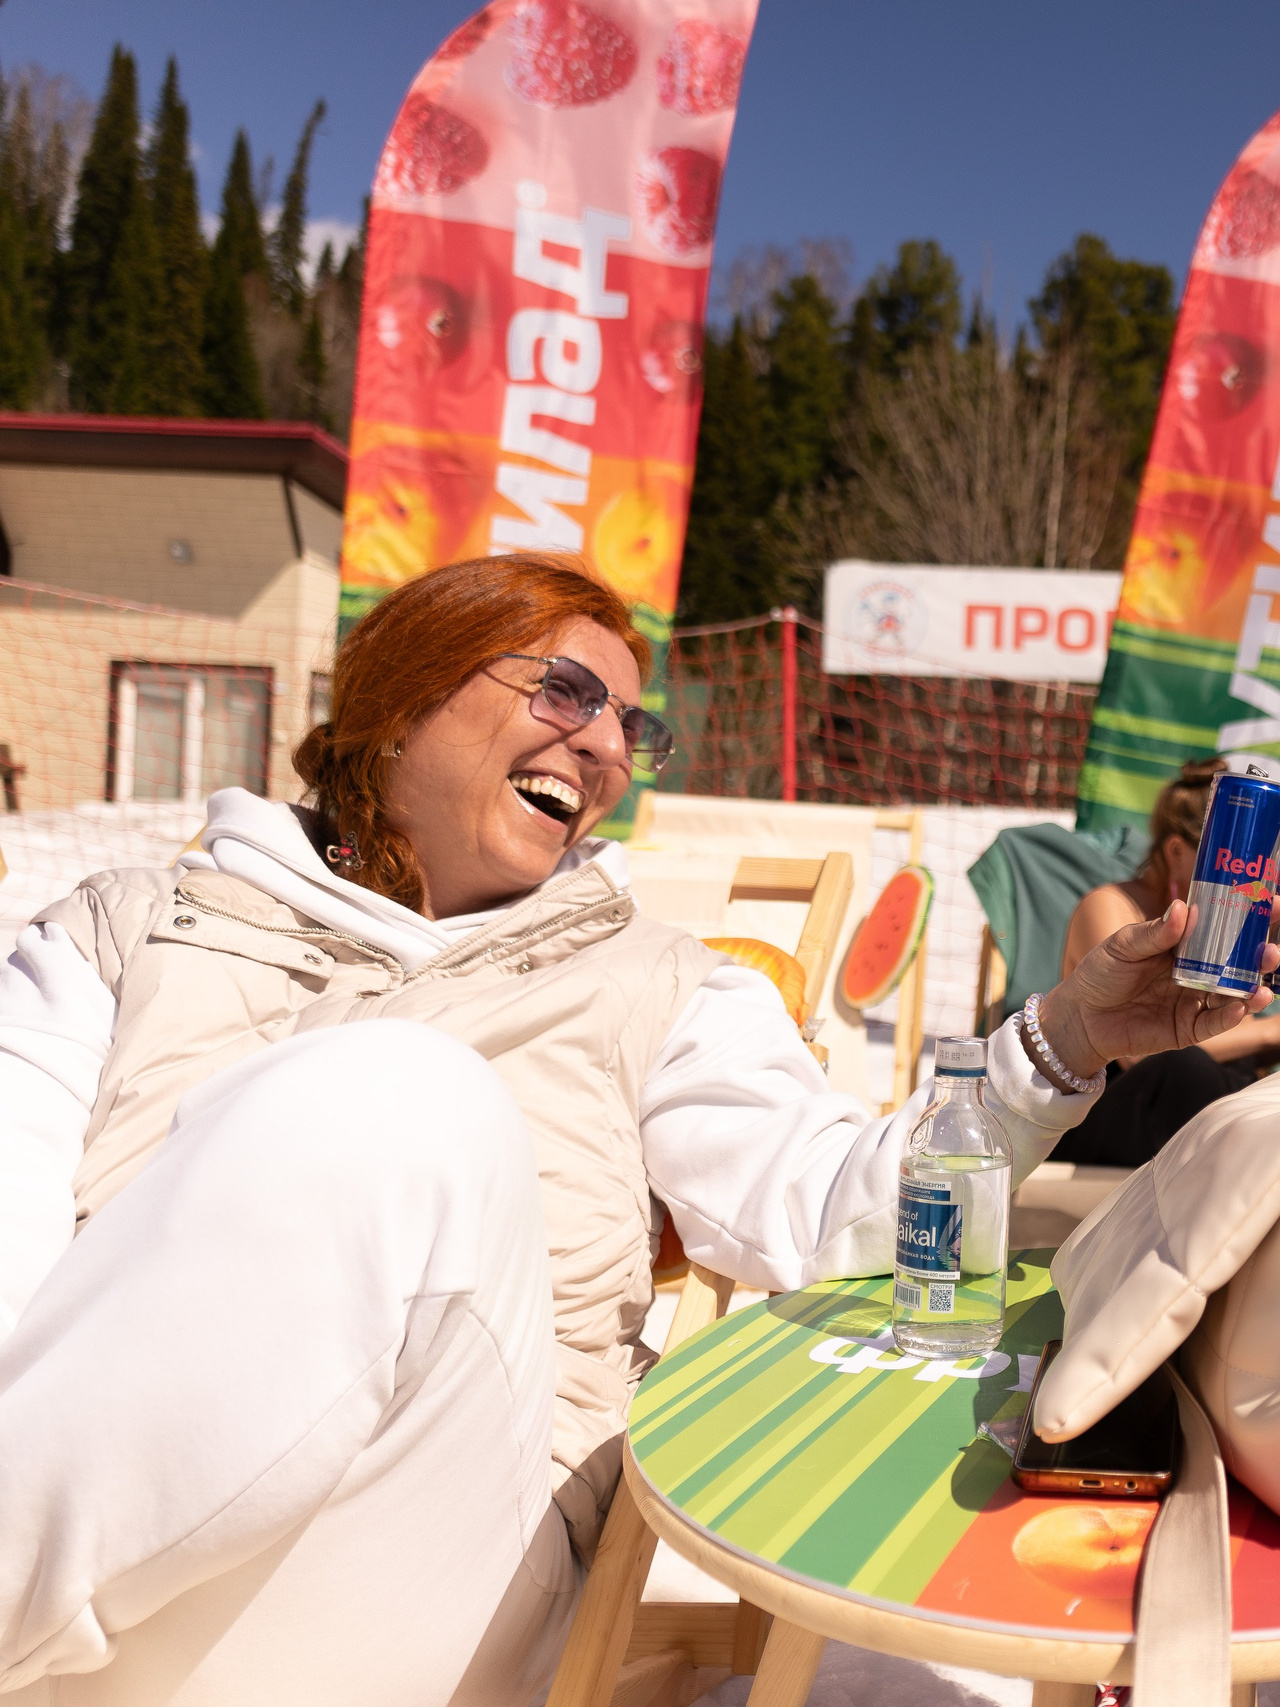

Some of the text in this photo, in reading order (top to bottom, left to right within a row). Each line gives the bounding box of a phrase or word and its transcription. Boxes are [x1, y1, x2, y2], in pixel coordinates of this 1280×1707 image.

[491, 207, 632, 556] илад
[963, 603, 1116, 654] ПРО
[1215, 848, 1263, 878] Red
[1211, 896, 1256, 914] ENERGY
[898, 1222, 936, 1248] aikal
